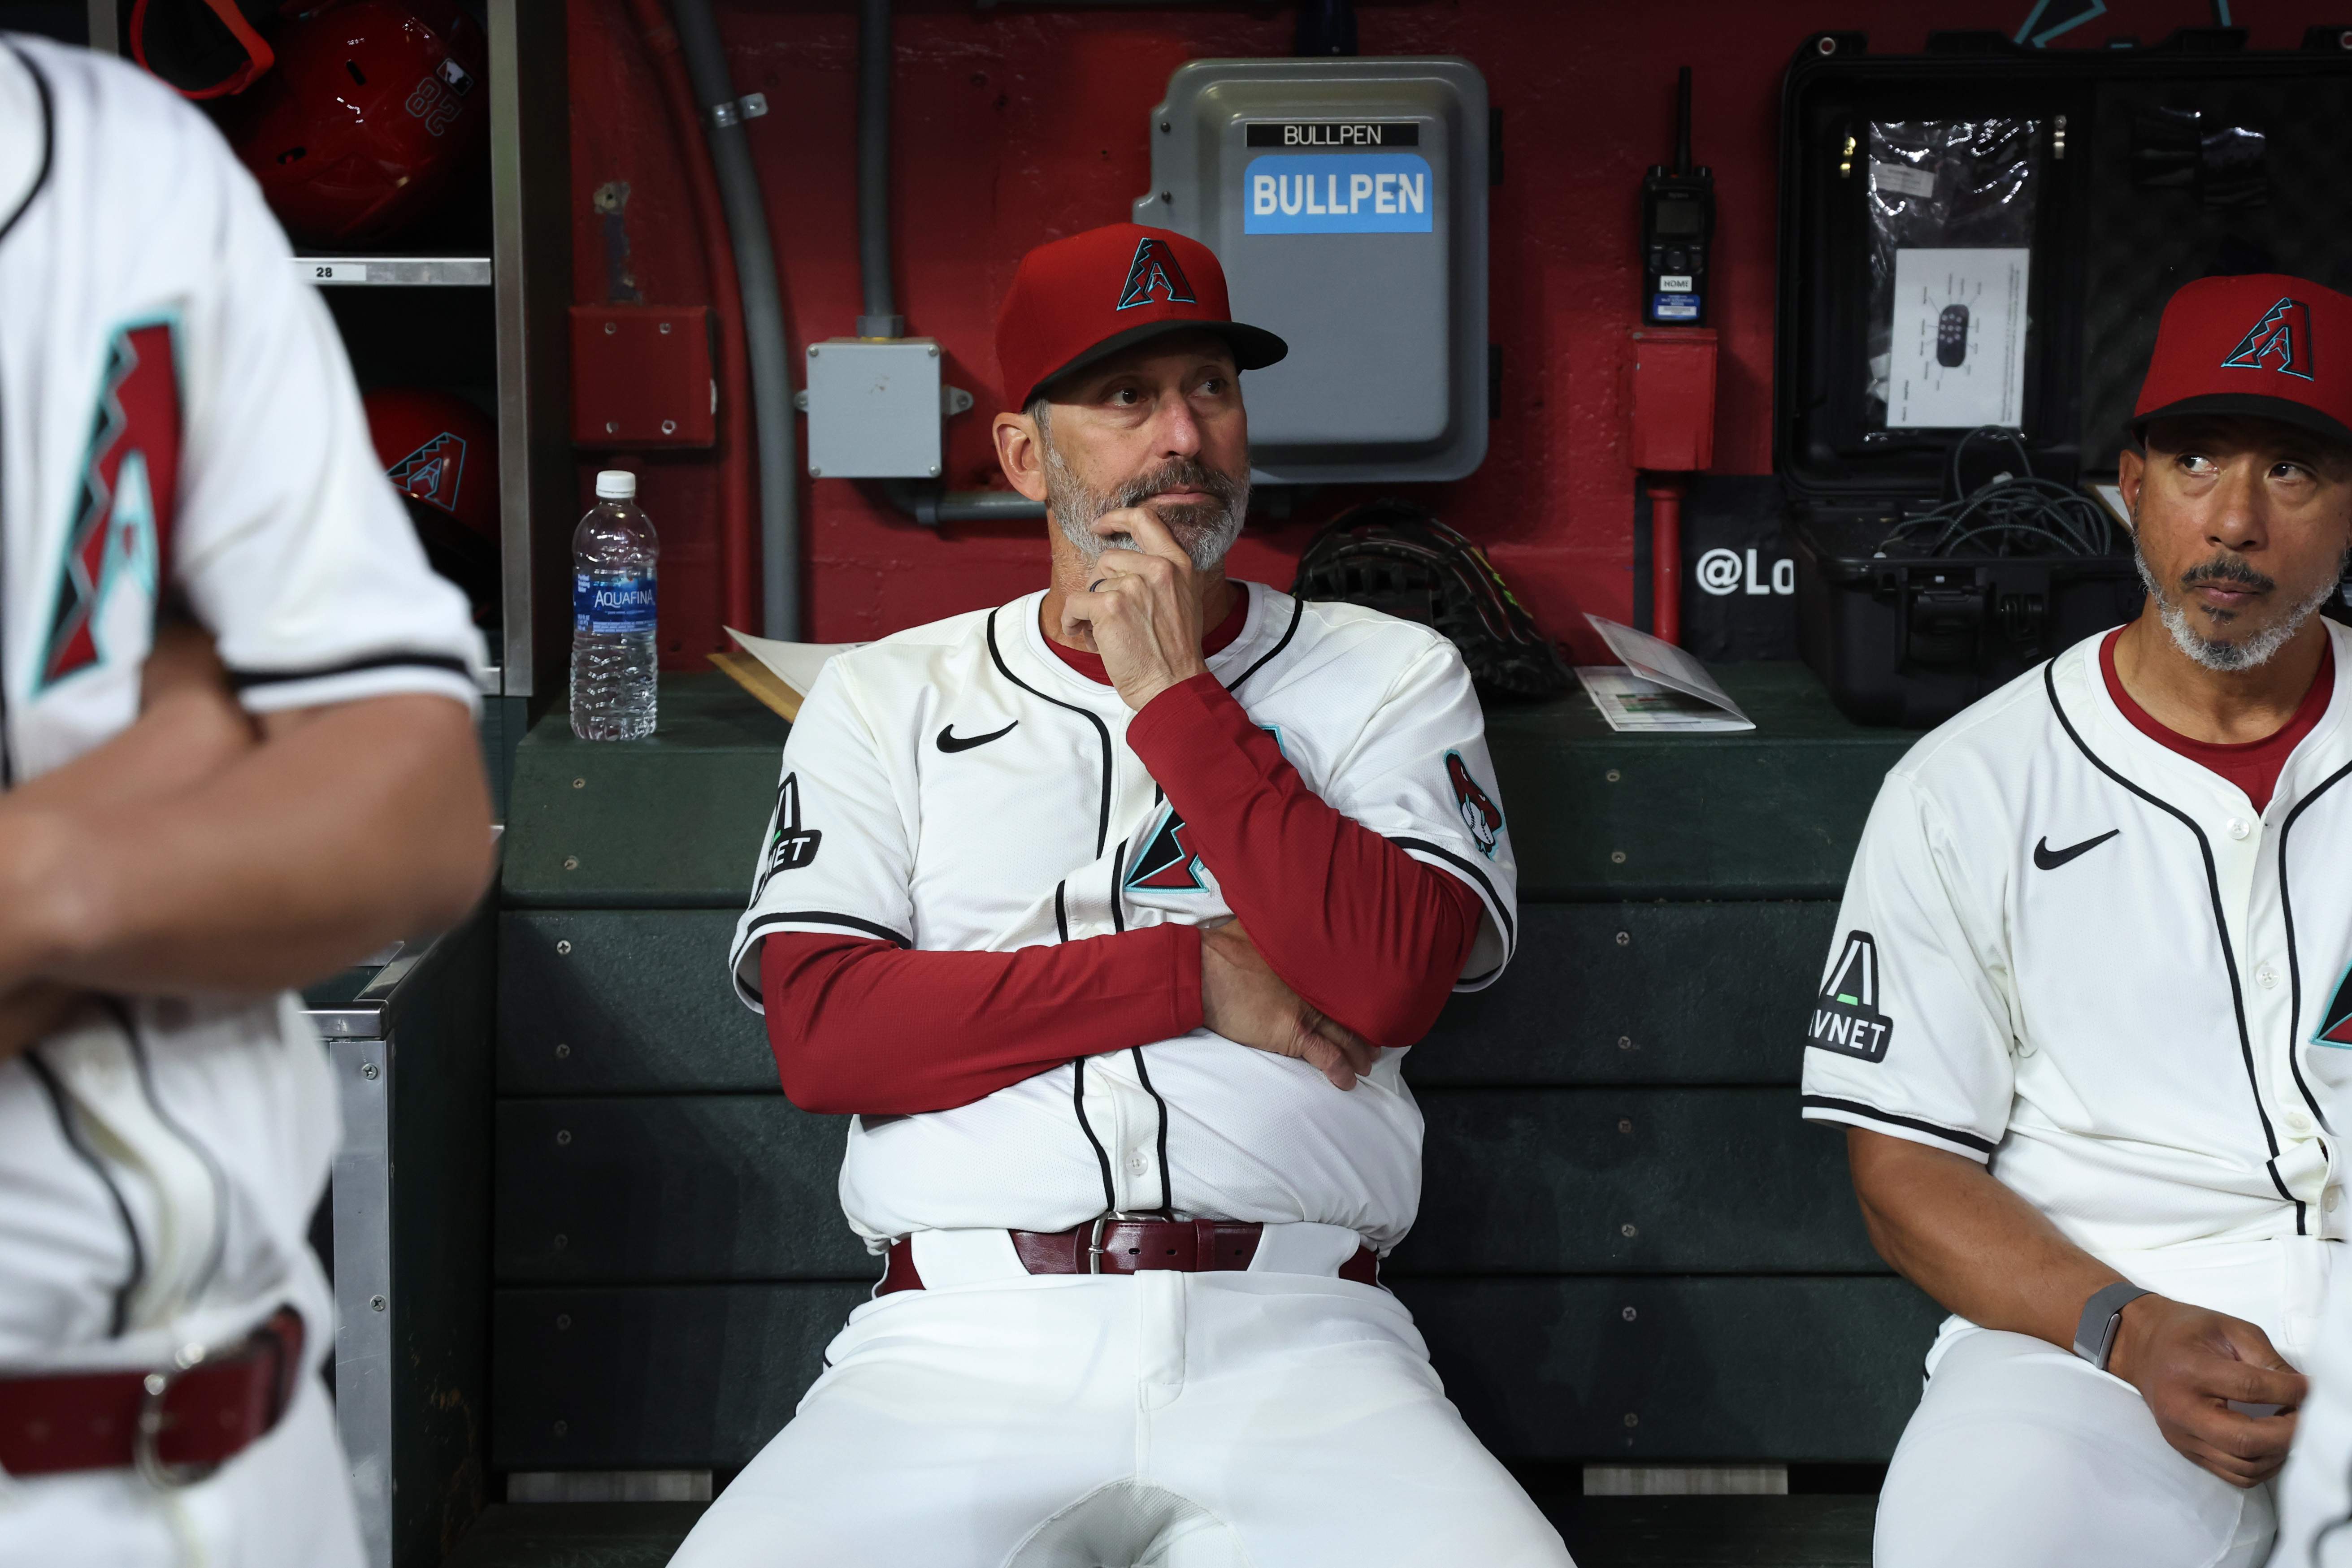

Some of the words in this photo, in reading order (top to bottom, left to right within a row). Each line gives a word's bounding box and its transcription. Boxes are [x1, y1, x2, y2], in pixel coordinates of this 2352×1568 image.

[1284, 125, 1382, 145] BULLPEN
[1254, 173, 1424, 215] BULLPEN
[317, 267, 332, 277] 28
[595, 589, 653, 608] AQUAFINA
